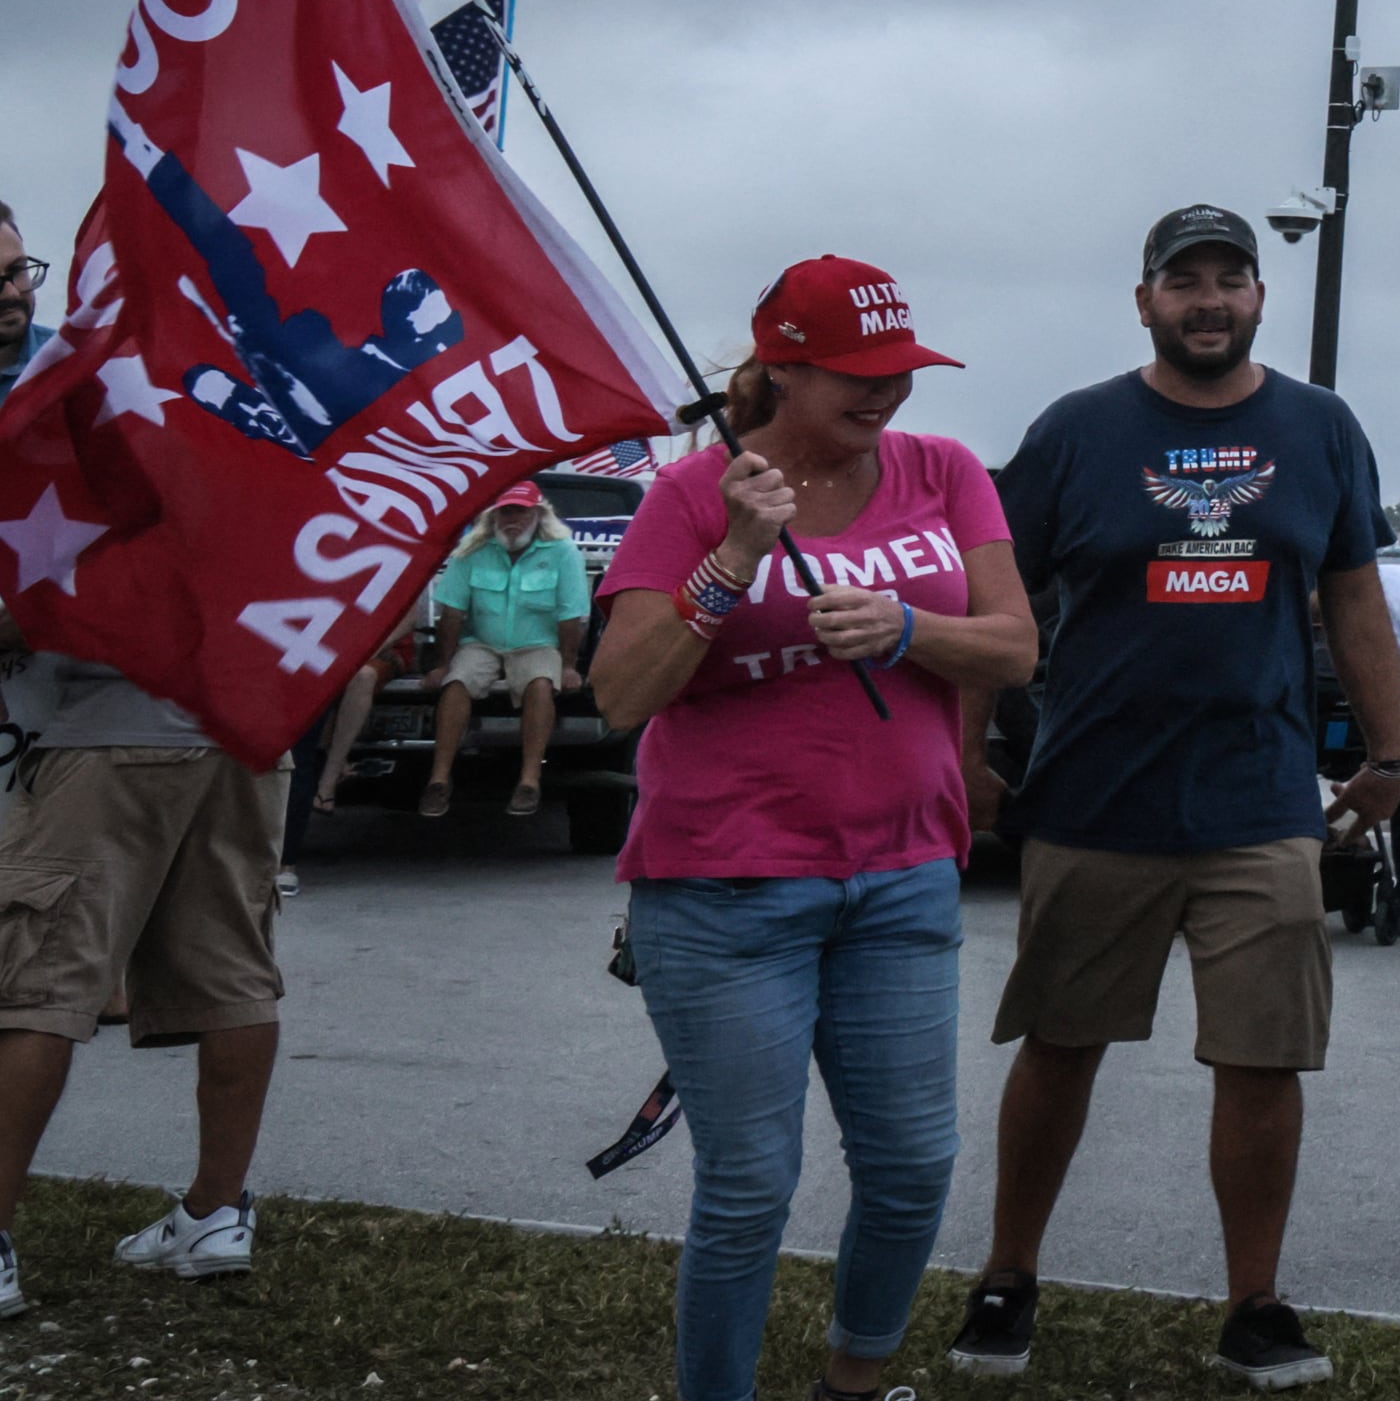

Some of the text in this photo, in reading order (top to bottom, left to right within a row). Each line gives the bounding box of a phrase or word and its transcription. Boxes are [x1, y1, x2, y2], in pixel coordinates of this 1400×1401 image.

[849, 283, 908, 308] ULTR
[860, 308, 914, 336] MAG
[1163, 446, 1258, 474] TRUMP
[1165, 570, 1250, 593] MAGA
